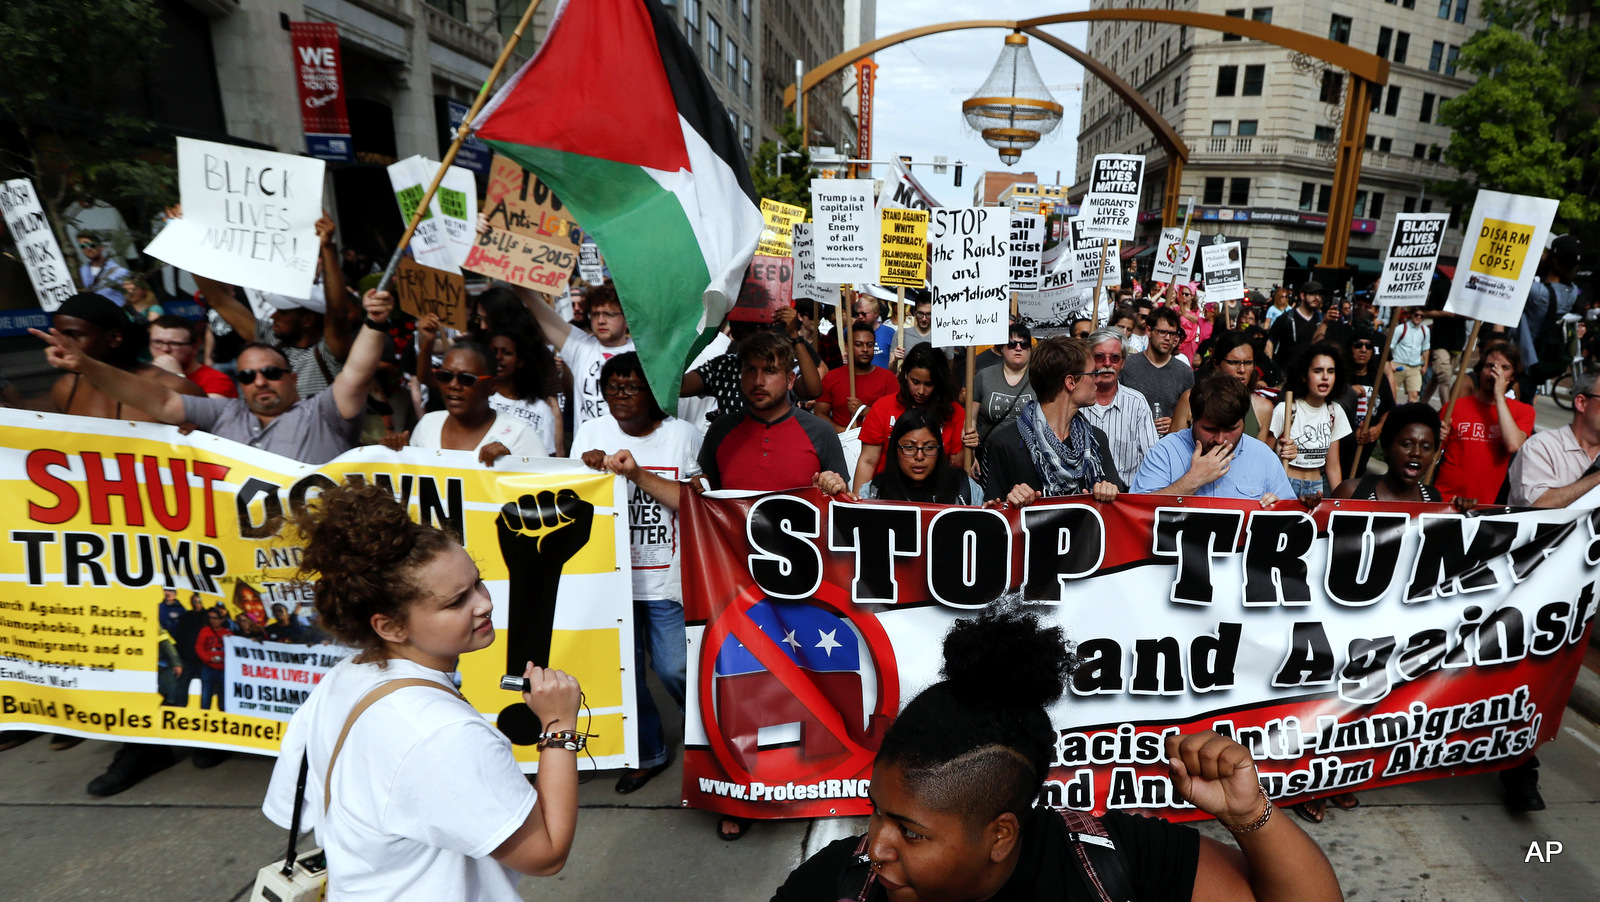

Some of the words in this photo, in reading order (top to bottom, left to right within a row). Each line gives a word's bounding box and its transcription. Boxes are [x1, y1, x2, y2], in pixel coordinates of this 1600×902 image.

[298, 46, 336, 67] WE
[1100, 160, 1136, 172] BLACK
[204, 154, 295, 200] BLACK
[1101, 170, 1132, 182] LIVES
[1096, 181, 1137, 192] MATTER
[818, 194, 848, 203] Trump
[225, 198, 292, 231] LIVES
[761, 202, 780, 214] STAND
[820, 204, 864, 212] capitalist
[1098, 208, 1126, 216] LIVES
[771, 214, 790, 226] WHITE
[832, 213, 846, 222] pig
[882, 210, 902, 221] STAND
[902, 212, 926, 222] AGAINST
[1092, 216, 1130, 226] MATTER
[795, 224, 808, 236] No
[828, 223, 860, 232] Enemy
[894, 222, 915, 234] WHITE
[934, 209, 988, 238] STOP
[1010, 218, 1036, 229] ail
[1402, 220, 1440, 232] BLACK
[479, 225, 518, 253] Bills
[522, 242, 532, 254] in
[830, 234, 840, 242] of
[842, 234, 854, 242] all
[883, 234, 925, 248] SUPREMACY,
[1164, 232, 1174, 240] NO
[1402, 232, 1435, 244] LIVES
[1480, 226, 1530, 246] DISARM
[200, 226, 297, 262] MATTER!
[826, 244, 864, 252] workers
[933, 244, 954, 262] the
[964, 236, 1008, 260] Raids
[1394, 242, 1437, 257] MATTER
[1490, 241, 1512, 256] THE
[798, 250, 810, 258] en
[885, 258, 922, 270] IMMIGRANT
[1010, 256, 1038, 267] iller
[1389, 262, 1432, 272] MUSLIM
[1480, 254, 1516, 271] COPS!
[888, 268, 918, 278] BASHING!
[952, 262, 980, 280] and
[1081, 266, 1116, 278] MATER
[1394, 272, 1424, 282] LIVES
[1387, 282, 1426, 292] MATTER
[932, 285, 1008, 310] Deportations
[936, 316, 968, 328] Workers
[976, 312, 998, 324] World
[952, 330, 975, 342] Party
[26, 448, 231, 538] SHUT
[629, 505, 662, 524] IVES
[630, 525, 672, 544] TTER.
[746, 494, 1106, 609] STOP
[11, 530, 226, 596] TRUMP
[0, 600, 24, 612] arch
[30, 602, 84, 616] Against
[90, 605, 148, 622] Racism,
[0, 616, 86, 636] lamophobia,
[91, 624, 145, 638] Attacks
[13, 635, 89, 652] Immigrants
[94, 644, 120, 655] and
[125, 648, 144, 656] on
[1069, 622, 1243, 696] and
[1271, 580, 1596, 705] Against
[234, 646, 248, 659] NO
[250, 648, 265, 661] TO
[266, 650, 318, 666] TRUMP'S
[89, 662, 114, 672] and
[1, 668, 46, 684] Endless
[49, 675, 78, 688] War!
[242, 664, 278, 680] BLACK
[282, 668, 310, 684] LIVES
[234, 682, 252, 700] NO
[258, 686, 311, 705] ISLAMO
[2, 695, 58, 718] Build
[63, 703, 153, 731] Peoples
[162, 710, 282, 740] Resistance!
[1033, 768, 1094, 810] nd
[1382, 713, 1542, 777] Attacks!
